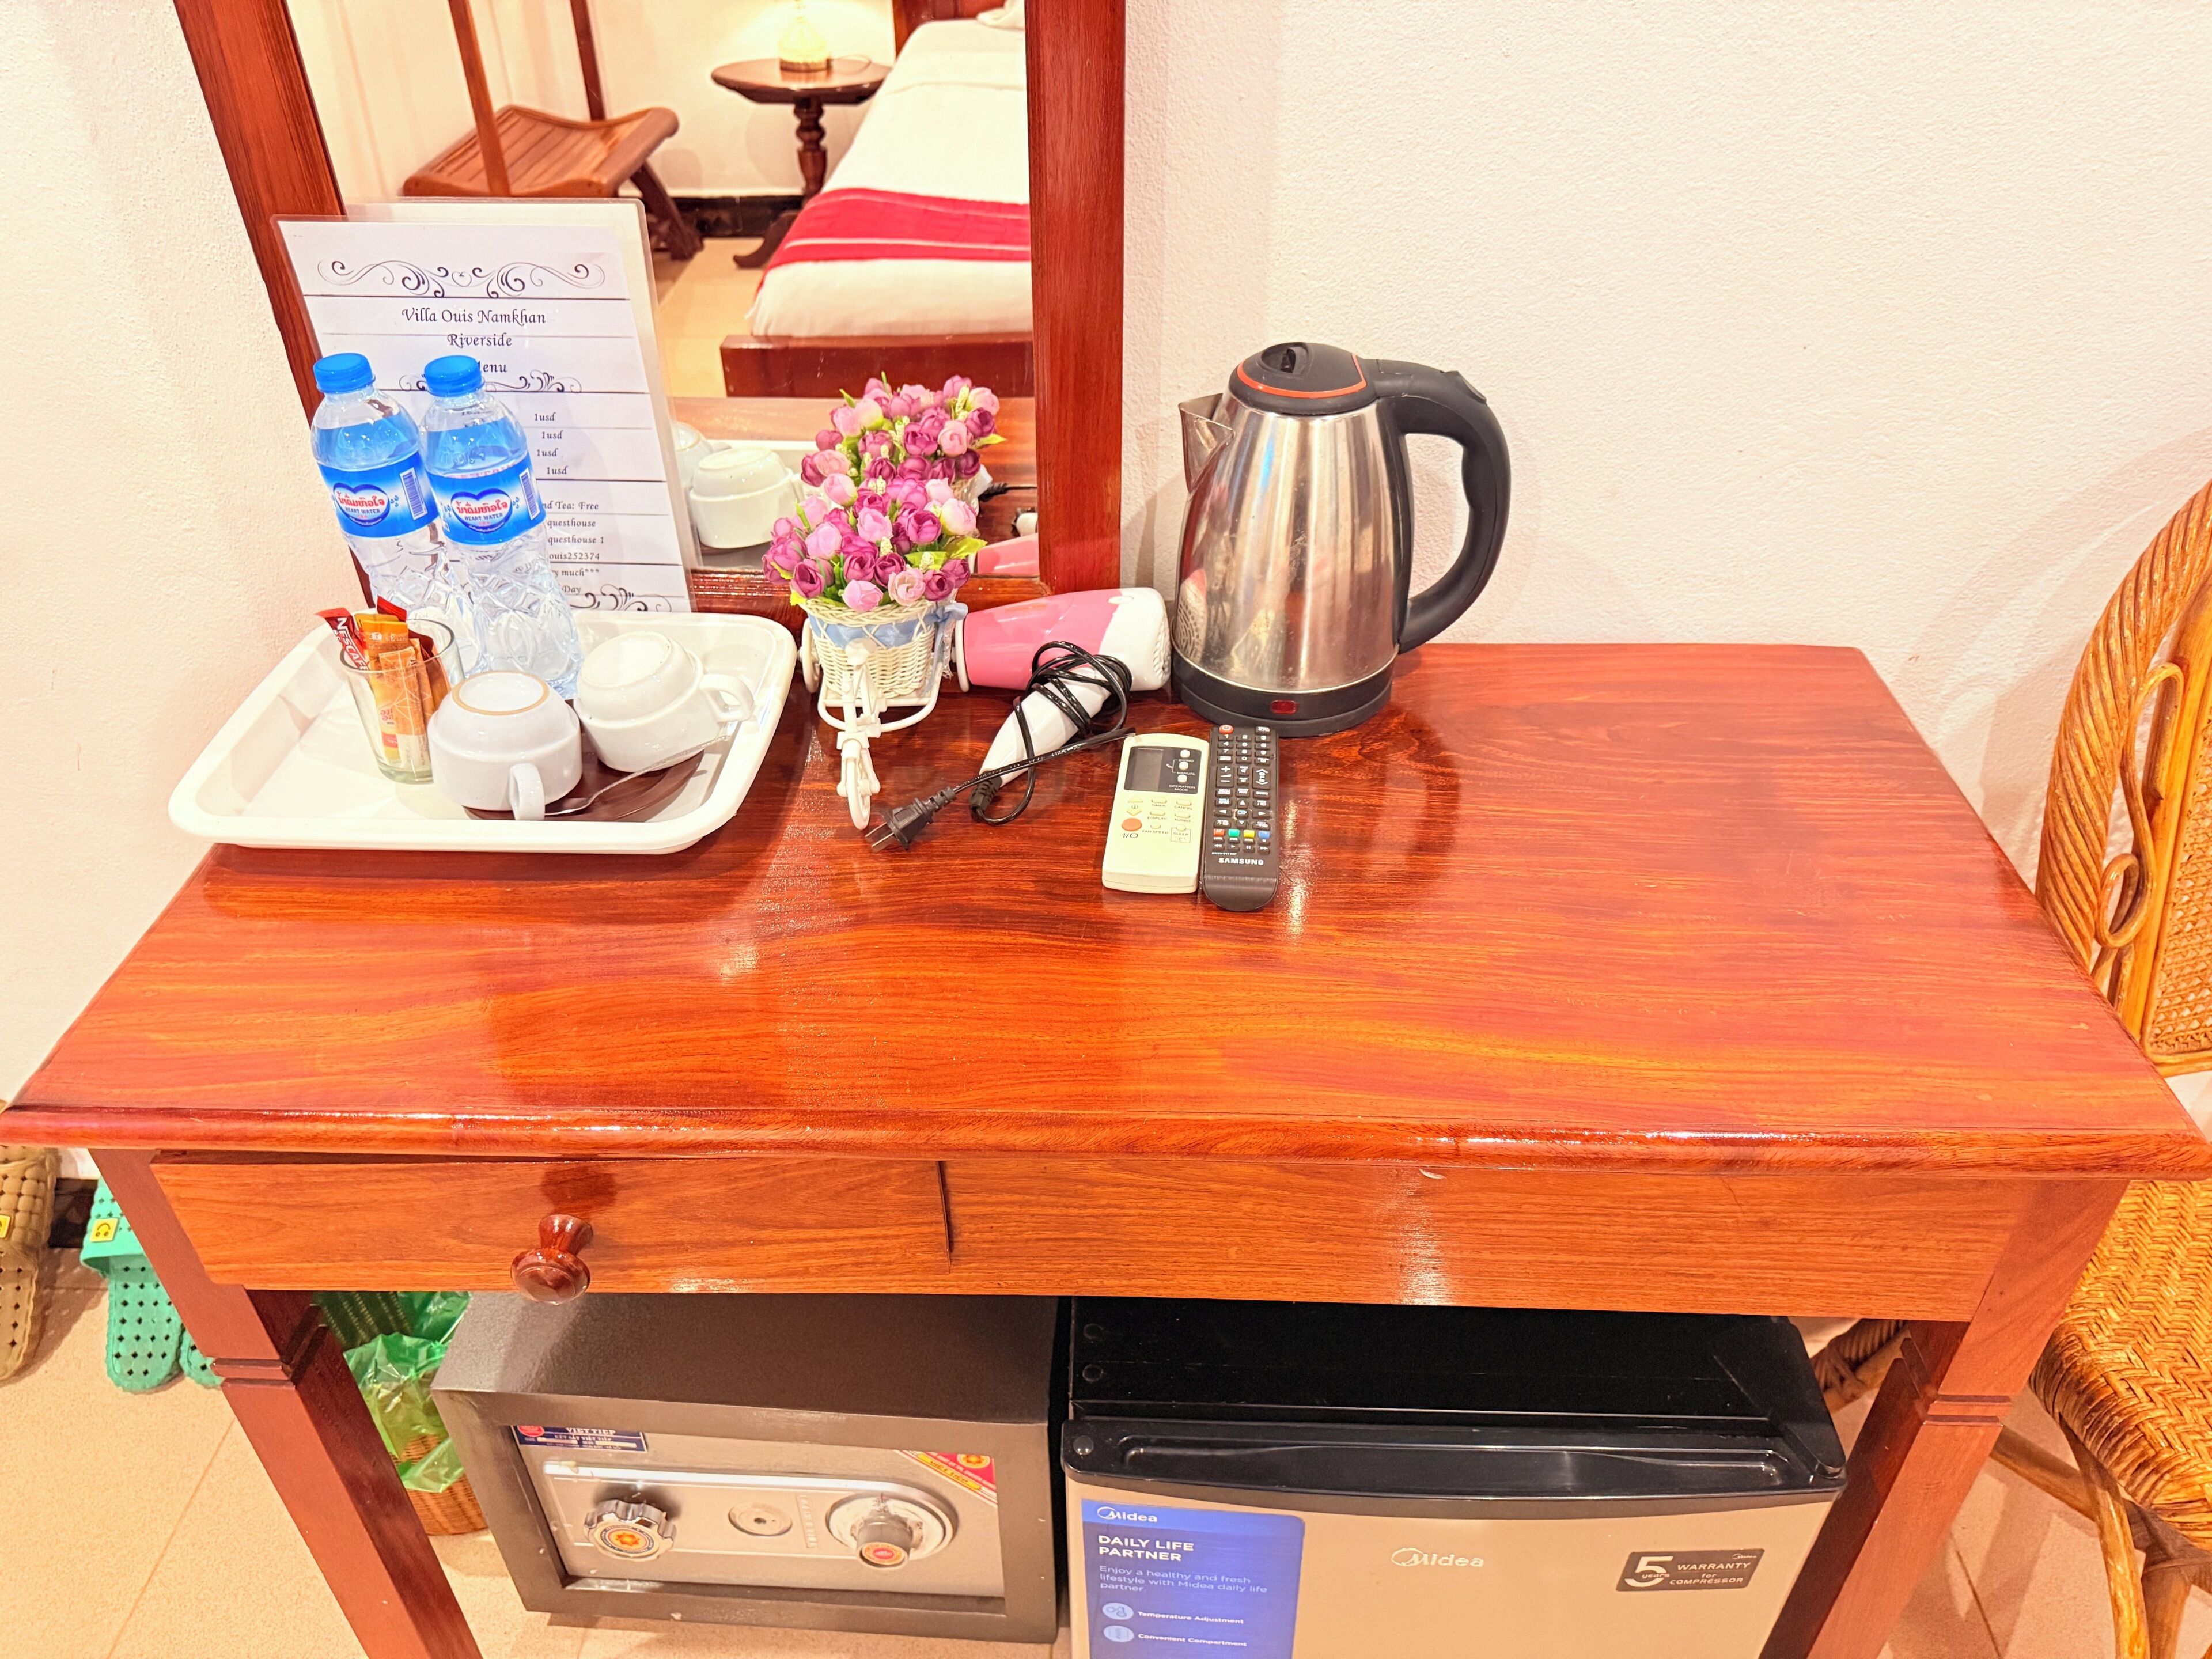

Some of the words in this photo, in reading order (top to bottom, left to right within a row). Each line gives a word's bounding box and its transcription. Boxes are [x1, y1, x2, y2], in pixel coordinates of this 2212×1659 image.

[402, 308, 437, 321] Villa
[442, 310, 474, 322] Ouis
[478, 309, 546, 326] Namkhan
[447, 333, 512, 348] Riverside
[478, 361, 507, 373] enu
[535, 412, 556, 421] 1usd
[542, 430, 564, 439] 1usd
[537, 448, 558, 457] 1usd
[547, 466, 569, 474] 1usd
[555, 501, 574, 510] Tea:
[578, 502, 599, 510] Free
[483, 512, 503, 520] WATER
[549, 552, 600, 560] ouis252374
[562, 585, 581, 595] Day
[1218, 857, 1264, 866] SAMSUNG
[1097, 1506, 1157, 1522] Midea
[1099, 1535, 1150, 1548] DAILY
[1156, 1540, 1194, 1551] LIFE
[1099, 1546, 1182, 1562] PARTNER
[1391, 1548, 1484, 1567] Midea
[1624, 1556, 1673, 1588] 5
[1677, 1562, 1751, 1571] WARRANTY
[1100, 1565, 1132, 1576] Enjoy
[1147, 1570, 1191, 1581] healthy
[1194, 1574, 1217, 1582] and
[1221, 1575, 1251, 1584] fresh
[1100, 1573, 1145, 1585] lifestyle
[1148, 1578, 1174, 1587] with
[1178, 1580, 1214, 1589] Midea
[1217, 1583, 1247, 1593] daily
[1138, 1611, 1192, 1621] Temperature
[1195, 1615, 1244, 1624] Adjustment
[1138, 1633, 1185, 1643] Convenient
[1188, 1637, 1247, 1647] Compartment
